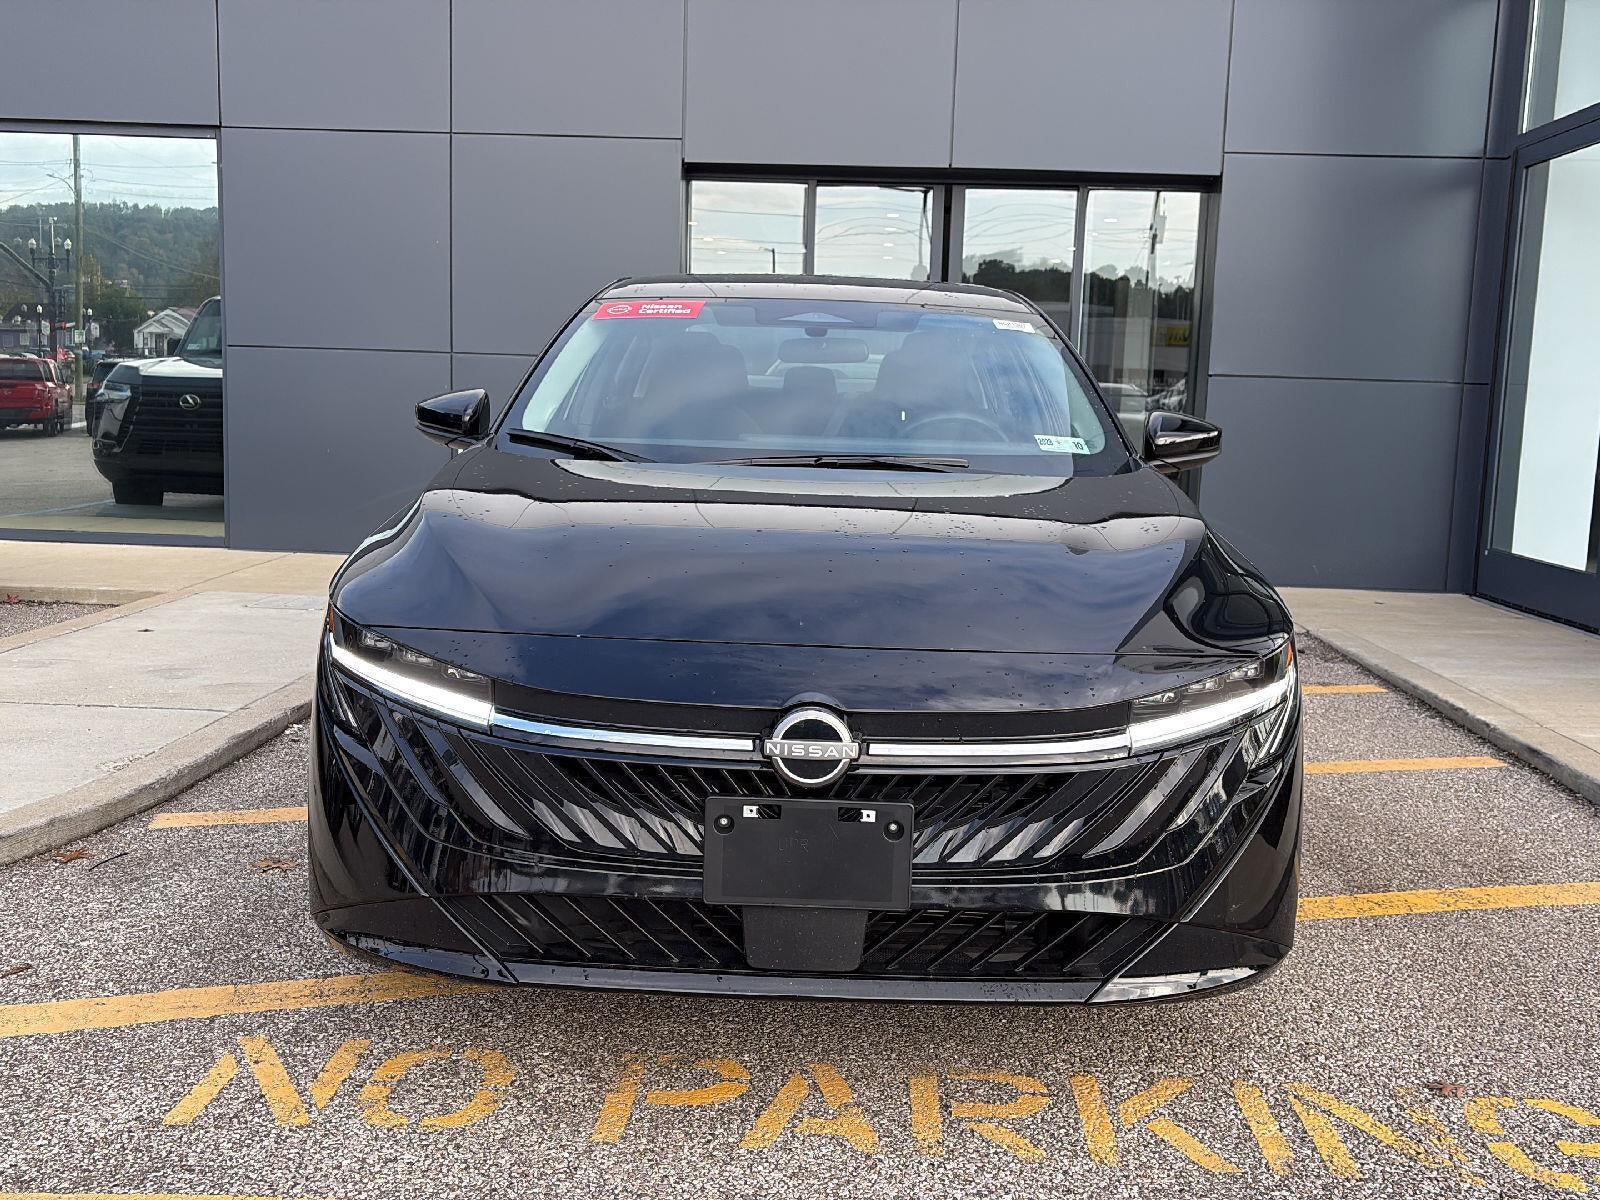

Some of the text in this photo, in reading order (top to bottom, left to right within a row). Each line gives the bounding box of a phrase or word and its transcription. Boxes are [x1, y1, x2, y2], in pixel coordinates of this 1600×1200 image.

[766, 742, 856, 758] NISSAN
[162, 1036, 1600, 1193] NO PARKING
